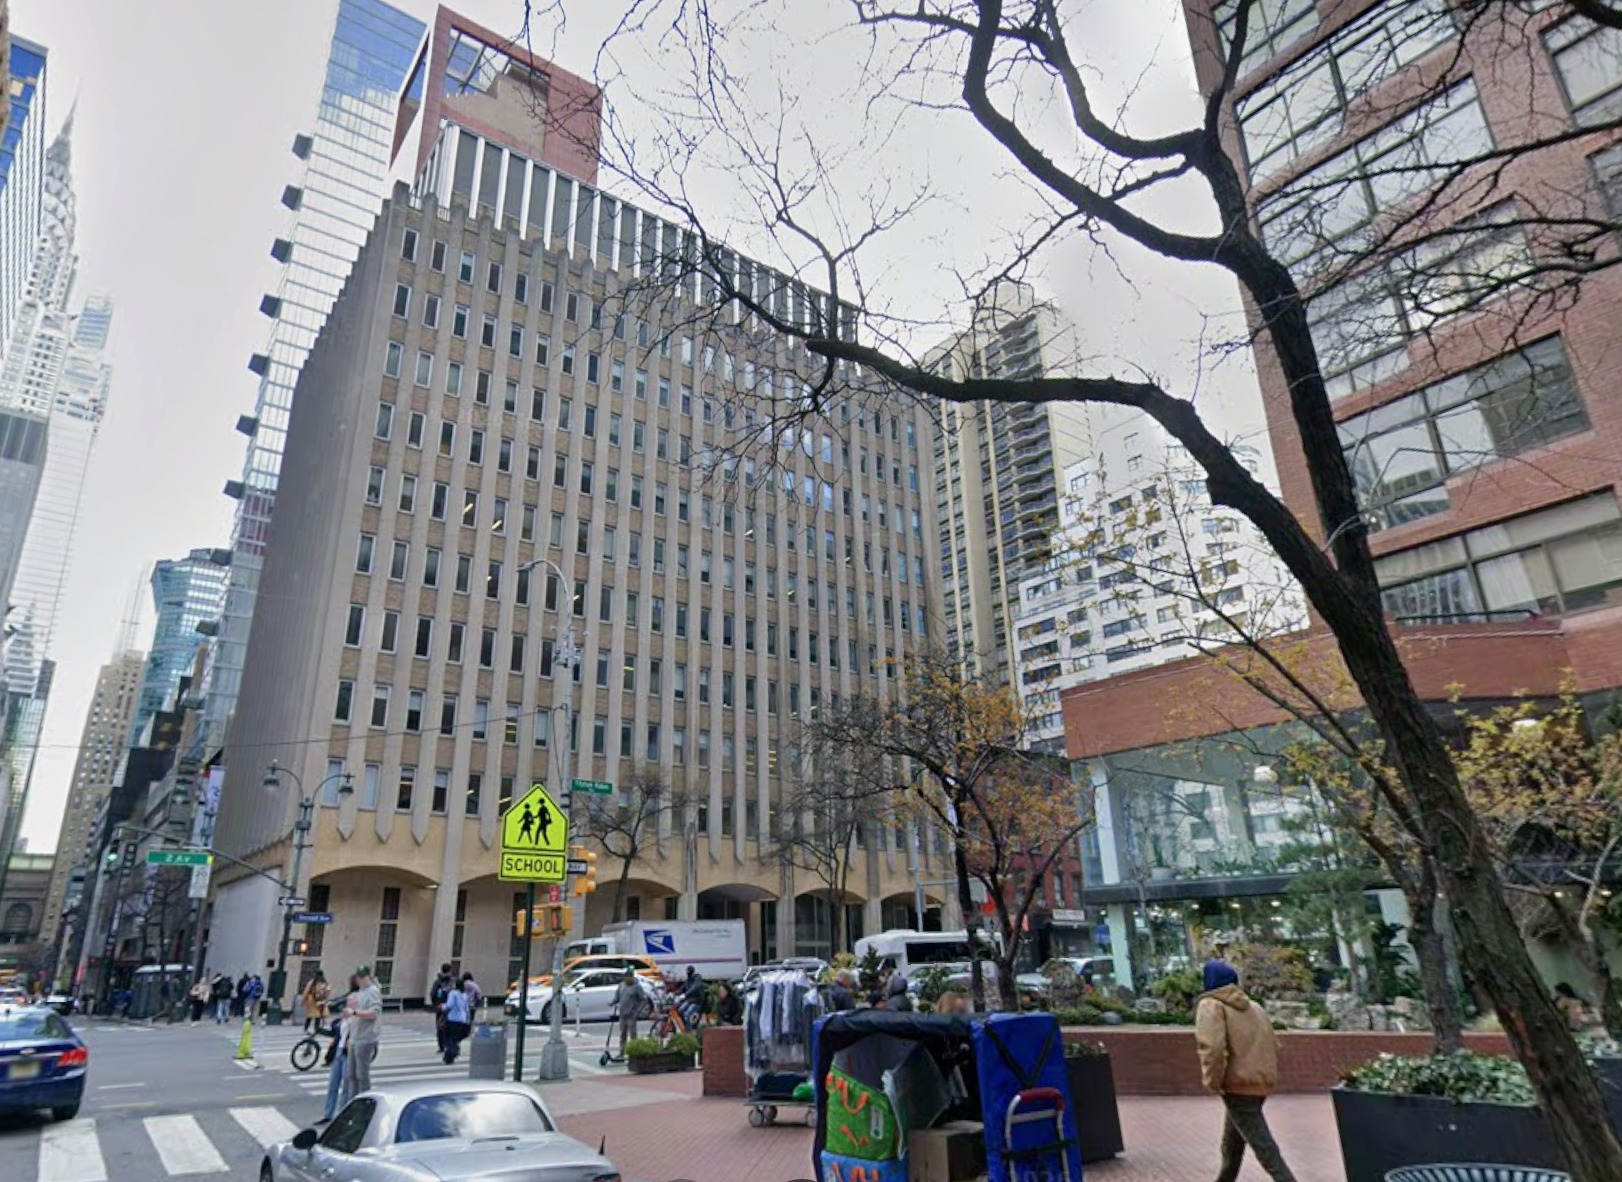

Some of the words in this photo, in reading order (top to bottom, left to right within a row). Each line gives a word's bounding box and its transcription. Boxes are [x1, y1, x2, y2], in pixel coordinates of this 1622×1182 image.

[165, 853, 173, 863] 2
[174, 854, 191, 864] Av
[505, 858, 561, 874] SCHOOL
